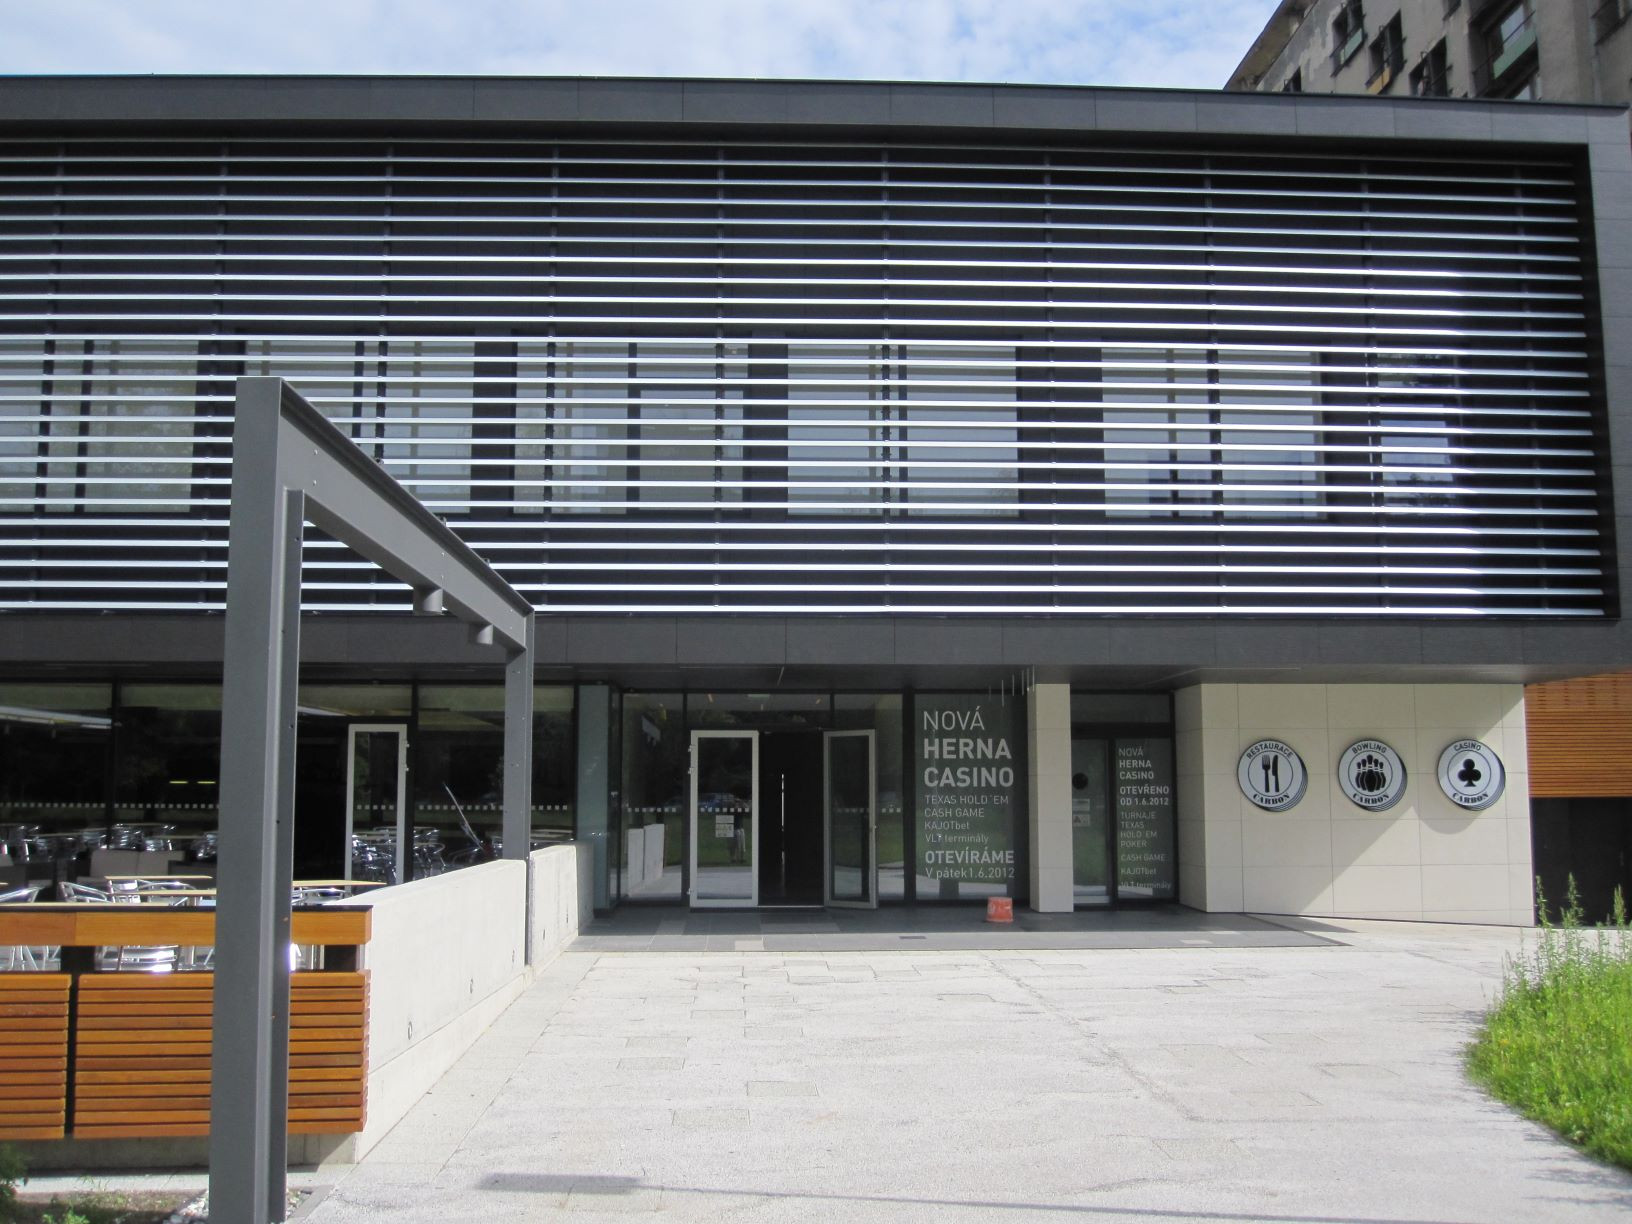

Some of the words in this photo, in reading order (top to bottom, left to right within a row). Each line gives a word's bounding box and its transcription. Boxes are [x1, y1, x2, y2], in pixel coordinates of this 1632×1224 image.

[923, 706, 985, 730] NOVÁ
[923, 738, 1012, 759] HERNA
[1118, 746, 1144, 757] NOVÁ
[1246, 742, 1293, 759] RESTAURACE
[1352, 742, 1387, 754] BOWLING
[1453, 742, 1482, 752] CASINO
[1119, 760, 1152, 769] HERNA
[924, 767, 1014, 787] CASINO
[1119, 771, 1154, 780] CASINO
[1120, 784, 1170, 795] OTEVŘENO
[924, 795, 957, 805] TEXAS
[1120, 797, 1132, 806] OD
[1135, 797, 1169, 806] 1.6.2012
[924, 808, 952, 818] CASH
[955, 808, 985, 818] GAME
[1120, 811, 1157, 820] TURNAJE
[924, 821, 970, 830] KAJOTbet
[1120, 821, 1145, 829] TEXAS
[944, 834, 989, 844] terminály
[1120, 840, 1147, 848] POKER
[925, 846, 1015, 864] OTEVÍRÁME
[925, 868, 933, 878] V
[936, 867, 967, 880] pátek
[969, 867, 1015, 879] 1.6.2012
